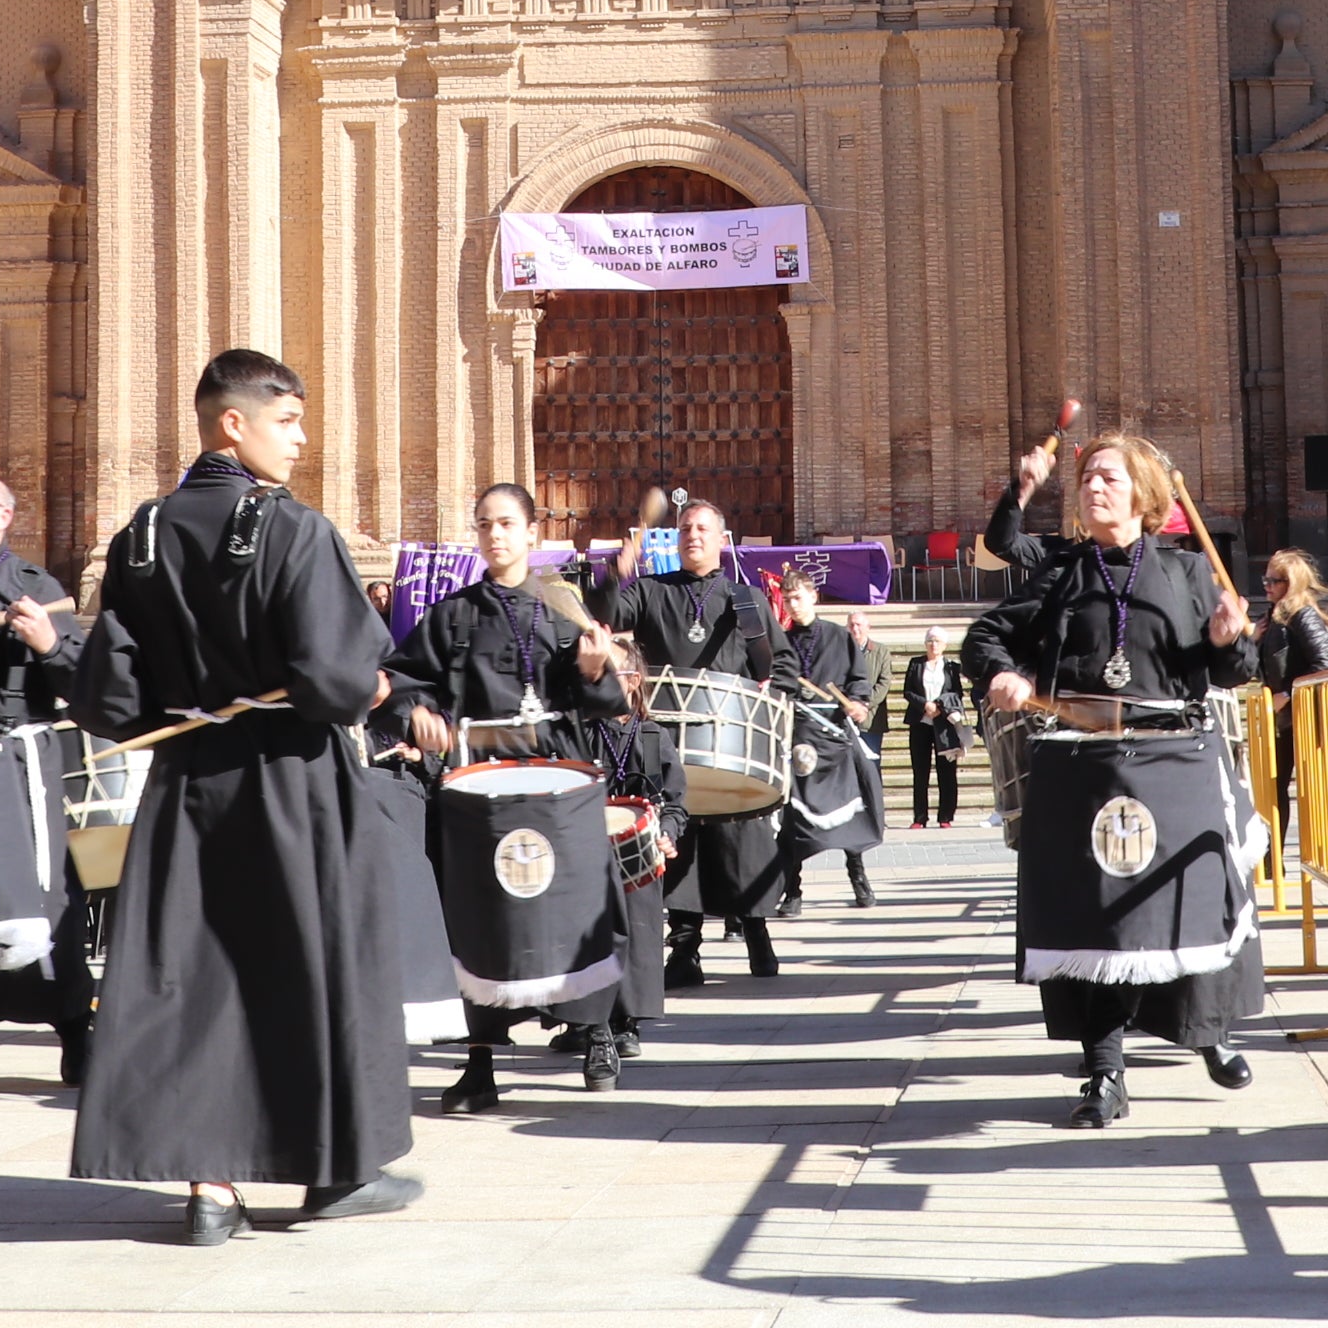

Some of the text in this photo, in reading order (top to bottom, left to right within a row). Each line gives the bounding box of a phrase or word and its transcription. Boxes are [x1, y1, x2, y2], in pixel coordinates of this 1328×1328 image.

[612, 225, 695, 239] EXALTACIÓN
[581, 242, 728, 256] TAMBORES Y BOMBOS
[592, 259, 718, 272] CIUDAD DE ALFARO
